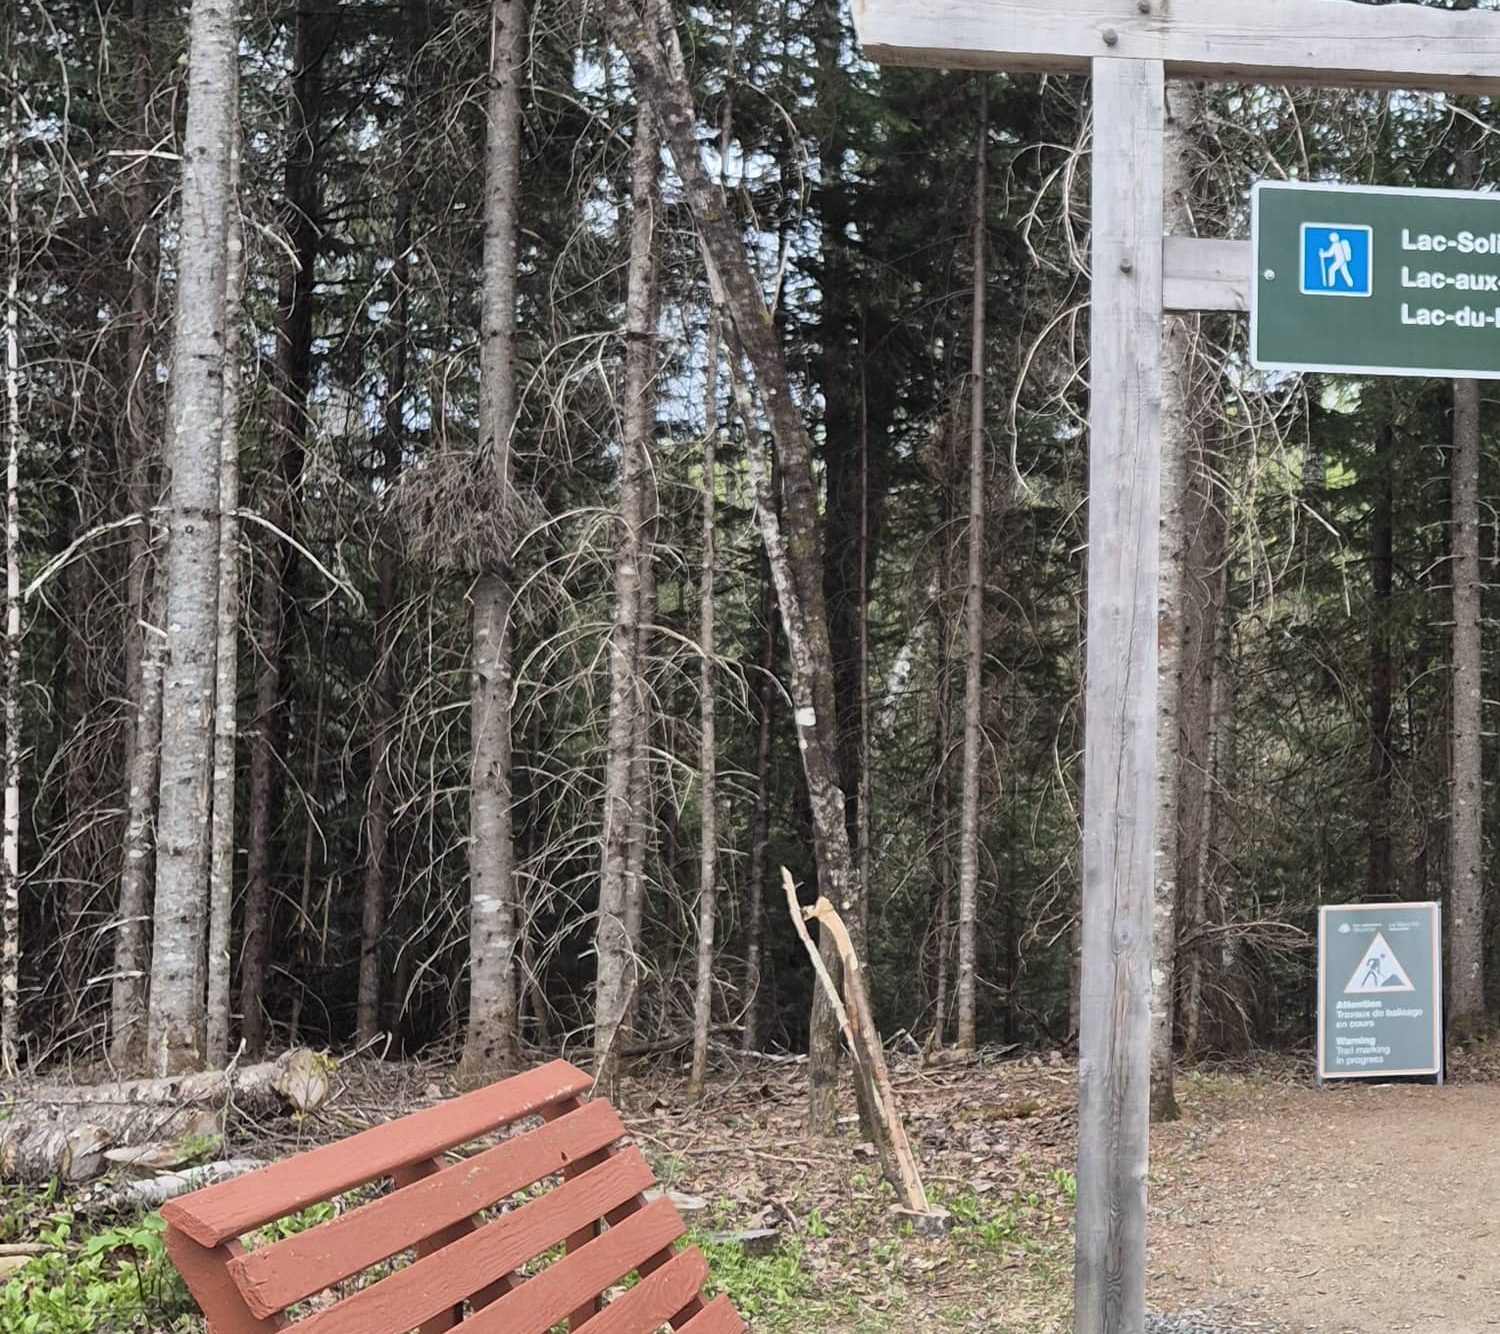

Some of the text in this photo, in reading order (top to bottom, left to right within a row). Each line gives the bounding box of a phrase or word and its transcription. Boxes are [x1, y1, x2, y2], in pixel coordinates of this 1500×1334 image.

[1336, 1000, 1382, 1009] Attention
[1336, 1010, 1371, 1019] Travaux
[1372, 1009, 1384, 1017] de
[1349, 1020, 1375, 1028] cours
[1336, 1036, 1376, 1046] Warning
